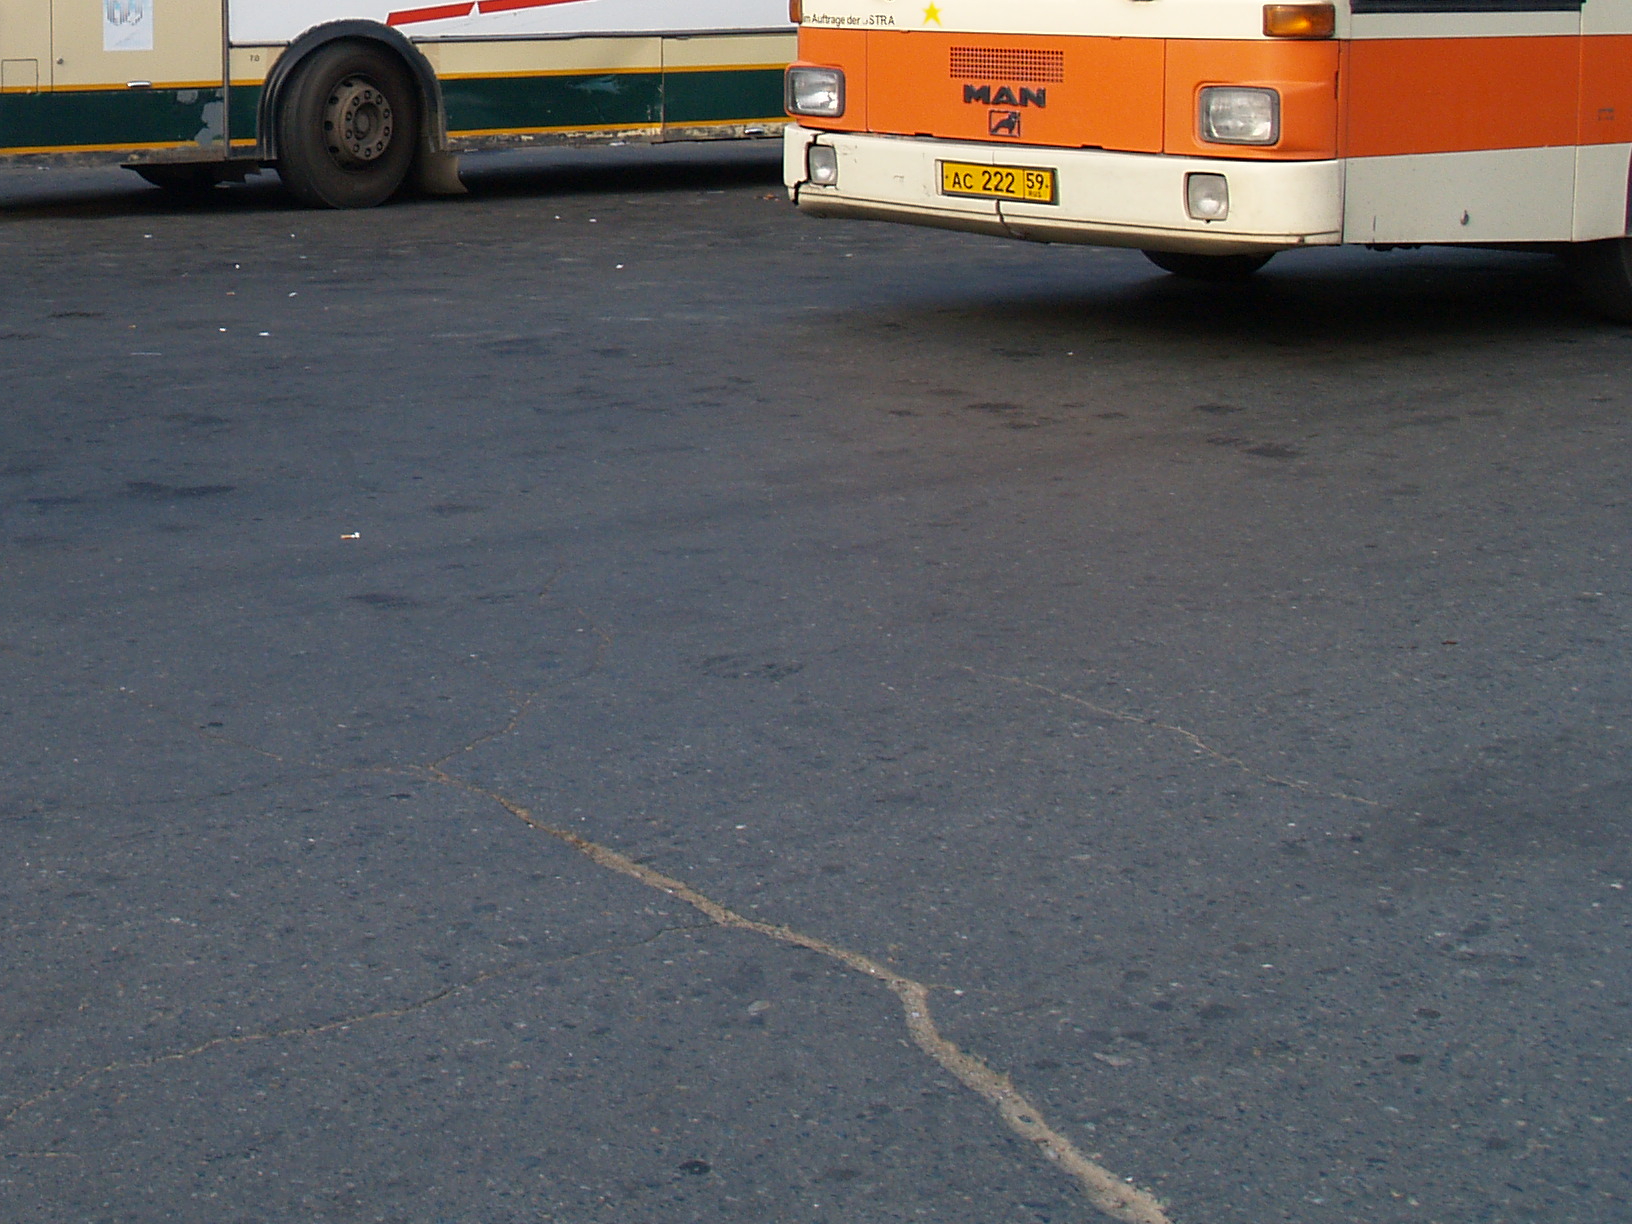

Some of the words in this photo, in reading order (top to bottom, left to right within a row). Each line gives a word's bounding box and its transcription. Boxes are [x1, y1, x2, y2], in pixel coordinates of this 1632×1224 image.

[847, 15, 861, 26] der
[963, 84, 1047, 109] MAN
[952, 171, 974, 190] AC
[981, 170, 1016, 194] 222
[1025, 172, 1044, 191] 59
